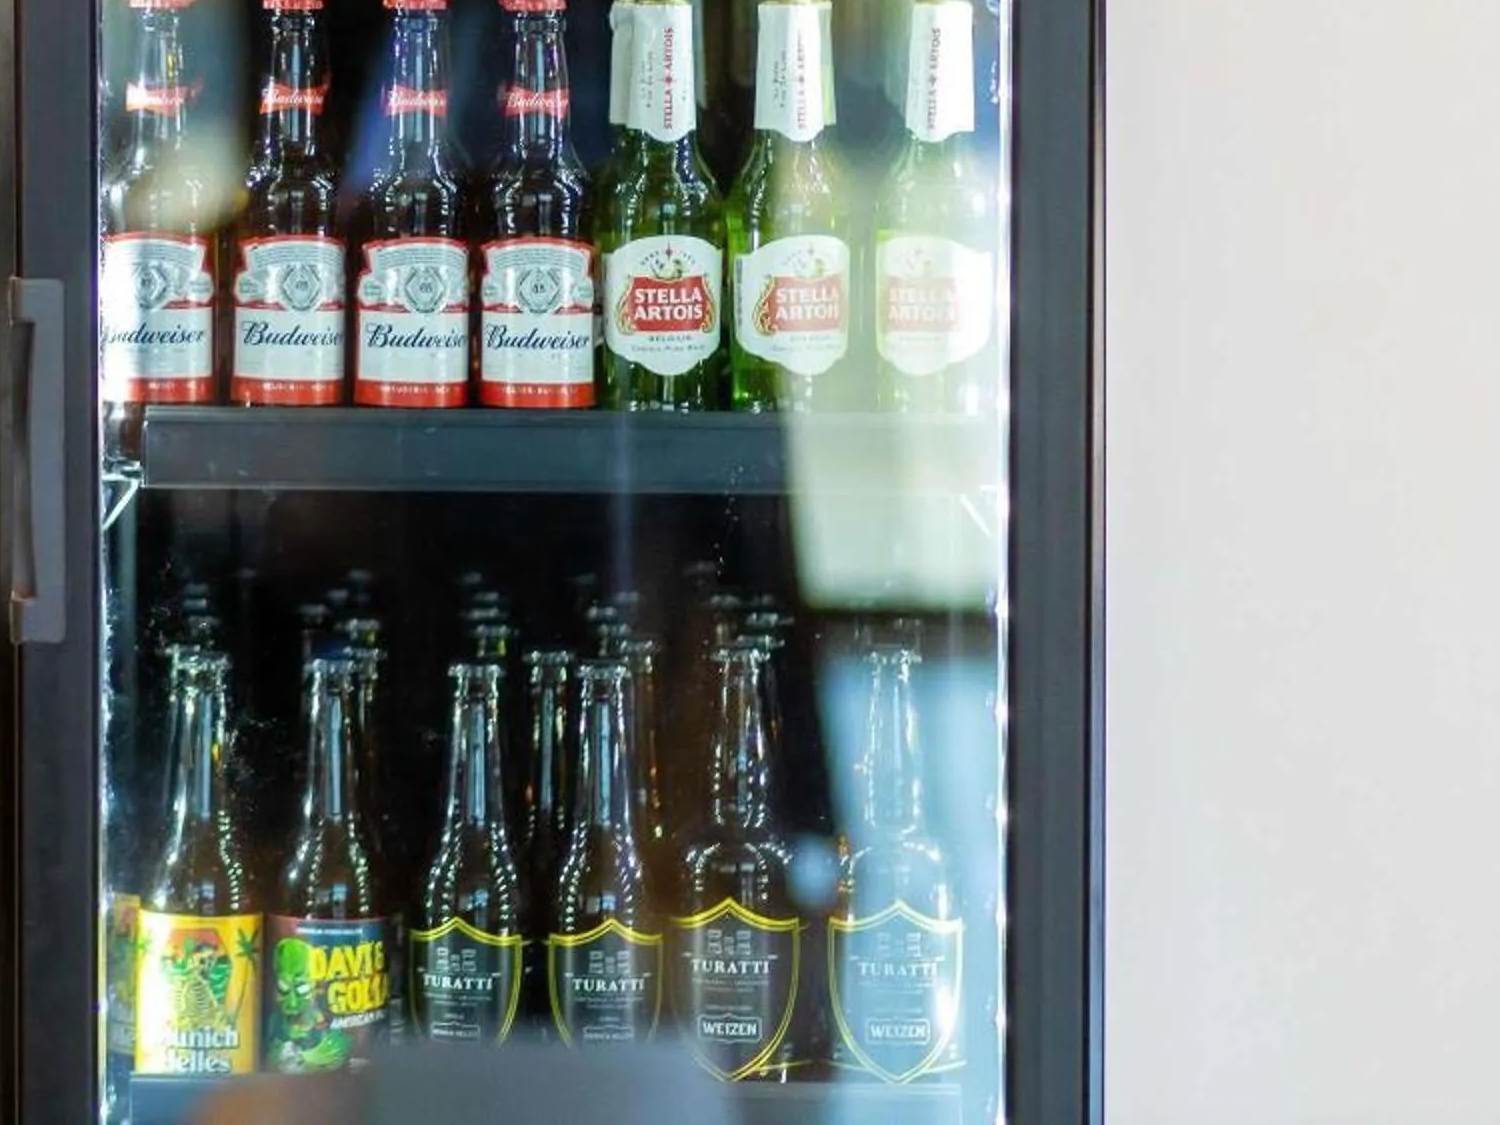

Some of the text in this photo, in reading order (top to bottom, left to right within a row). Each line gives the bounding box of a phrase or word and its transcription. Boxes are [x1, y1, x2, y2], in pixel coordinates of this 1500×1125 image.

[663, 27, 674, 129] STELLA ARTOIS
[635, 287, 703, 303] STELLA
[634, 304, 703, 320] ARTOIS
[104, 321, 205, 345] udweiser
[691, 959, 771, 975] TURATTI
[858, 962, 938, 977] TURATTI
[422, 974, 494, 990] TURATTI
[573, 977, 645, 992] TURATTI
[163, 1025, 240, 1048] unich
[702, 1021, 758, 1037] WEIZEN
[869, 1024, 927, 1040] WEIZEN
